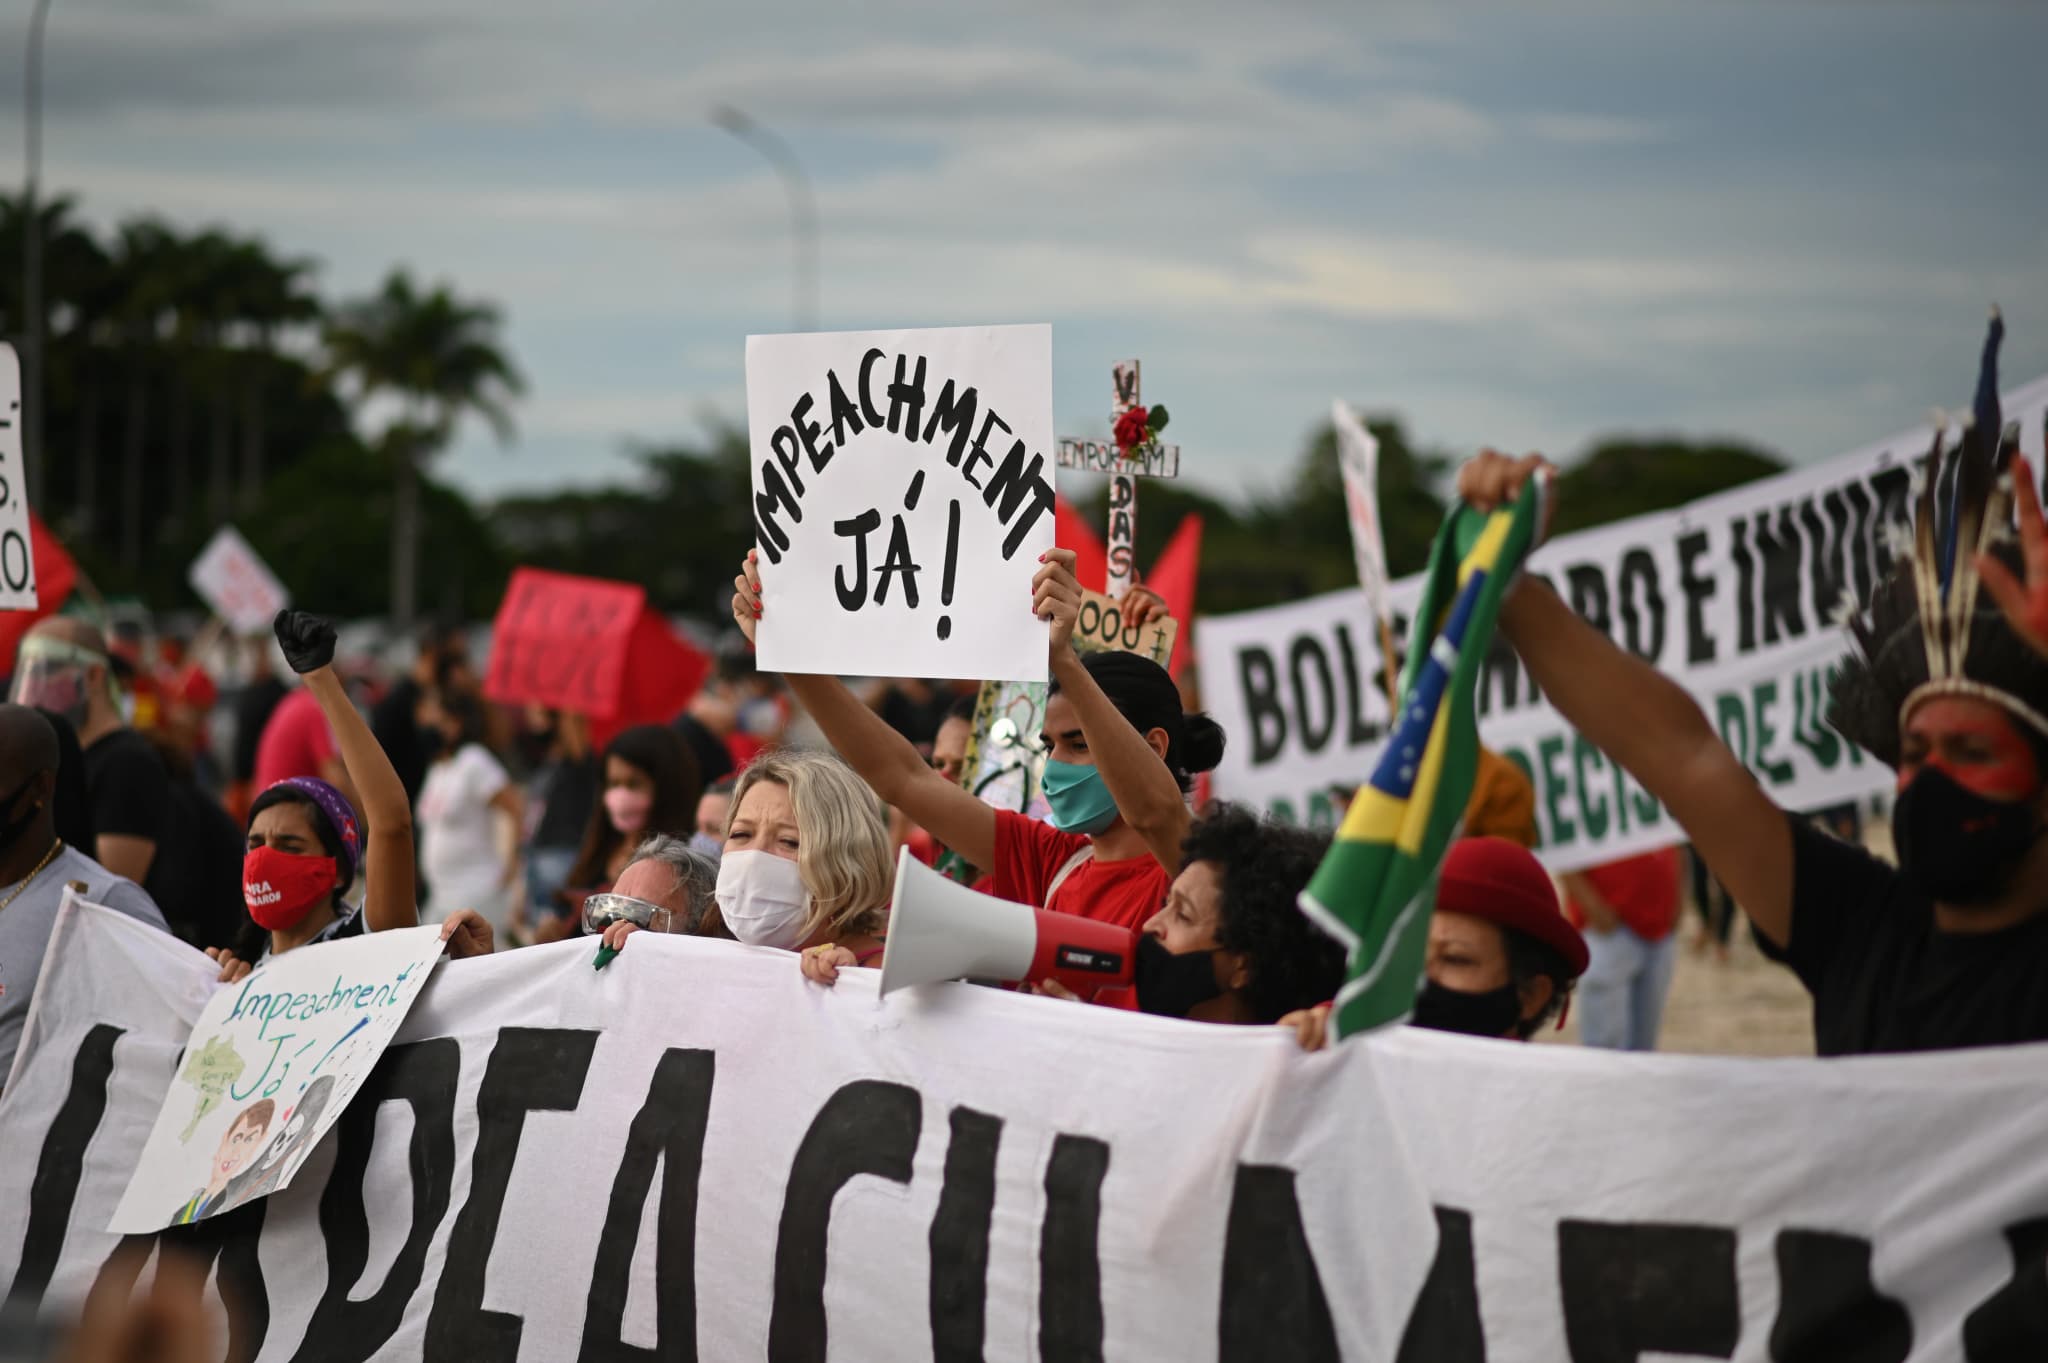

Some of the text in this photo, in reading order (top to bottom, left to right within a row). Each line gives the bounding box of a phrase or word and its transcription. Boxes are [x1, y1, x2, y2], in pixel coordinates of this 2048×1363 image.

[755, 347, 1056, 565] IMPEACHMENT
[1108, 367, 1137, 579] VDAS
[222, 962, 416, 1040] Impeachment
